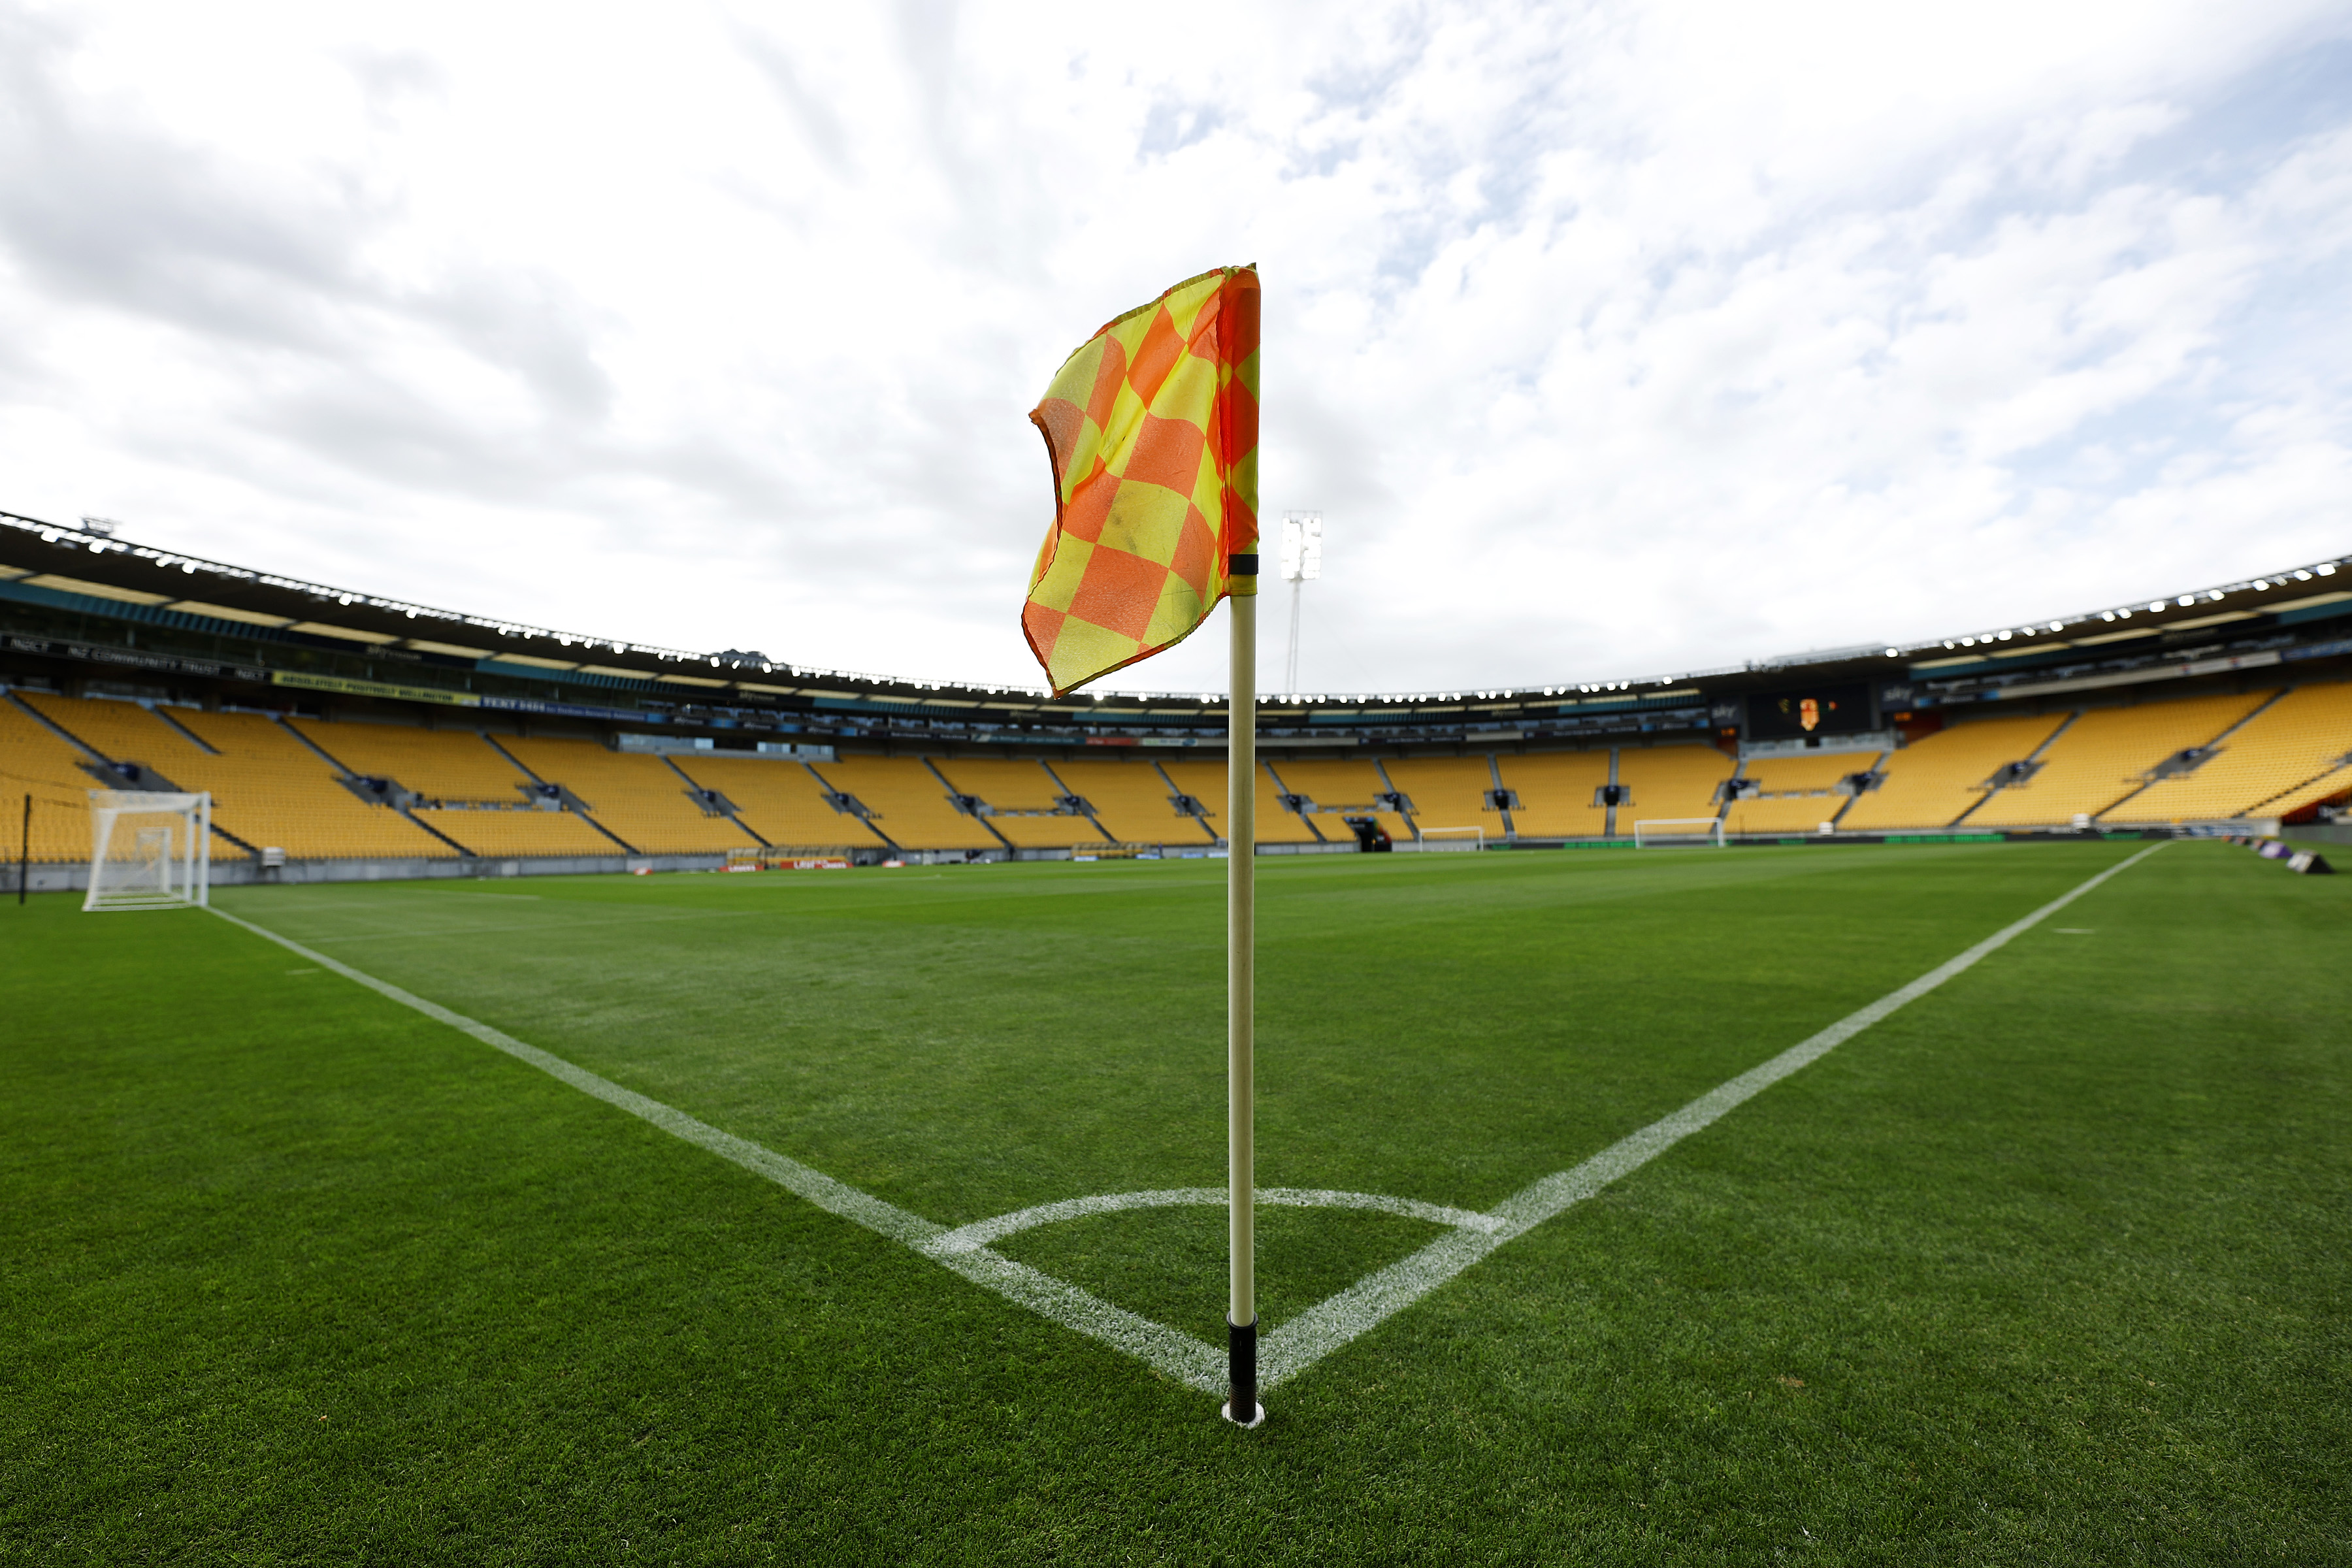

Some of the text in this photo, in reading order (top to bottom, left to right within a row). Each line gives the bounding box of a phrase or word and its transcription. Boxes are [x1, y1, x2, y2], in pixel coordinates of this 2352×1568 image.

[91, 648, 178, 670] COMMUNITY
[1882, 686, 1914, 702] sky
[1712, 703, 1738, 719] sky
